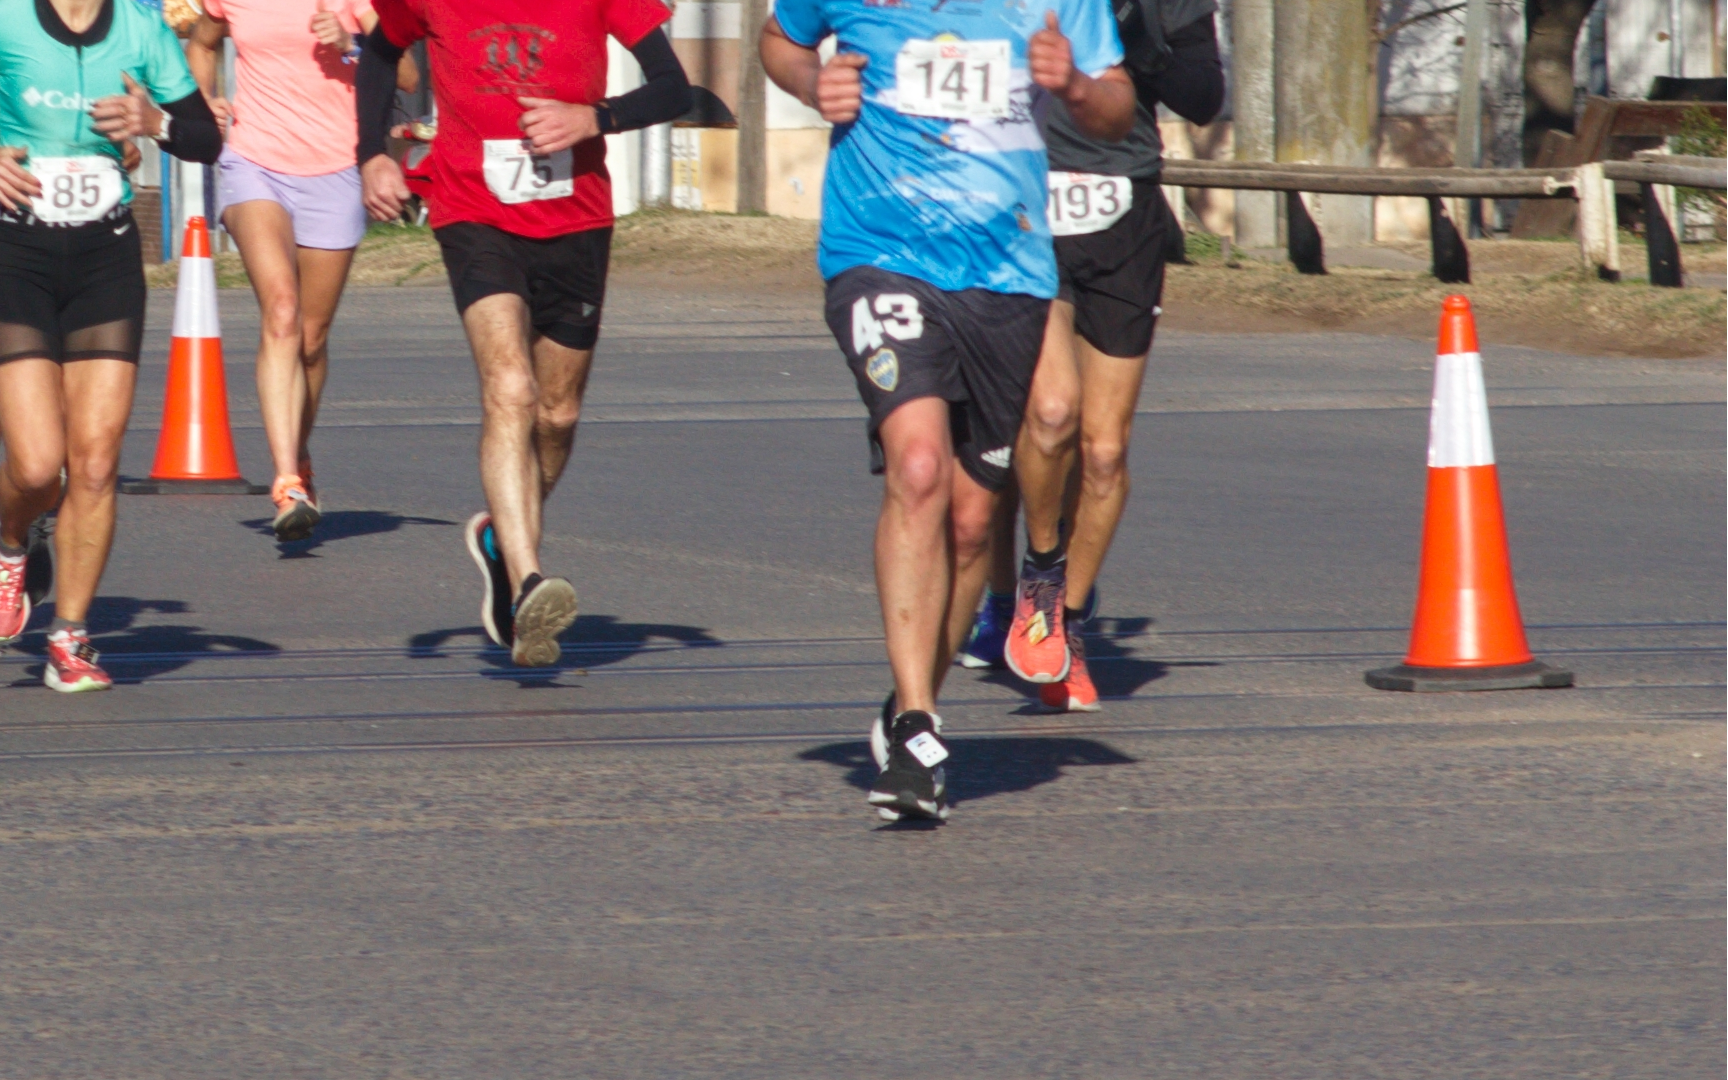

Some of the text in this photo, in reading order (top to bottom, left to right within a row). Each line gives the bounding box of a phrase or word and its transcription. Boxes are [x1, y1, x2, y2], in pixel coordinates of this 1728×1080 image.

[916, 60, 991, 103] 141
[52, 174, 101, 208] 85
[504, 155, 553, 191] 75
[1049, 180, 1120, 222] 193
[852, 293, 925, 356] 43
